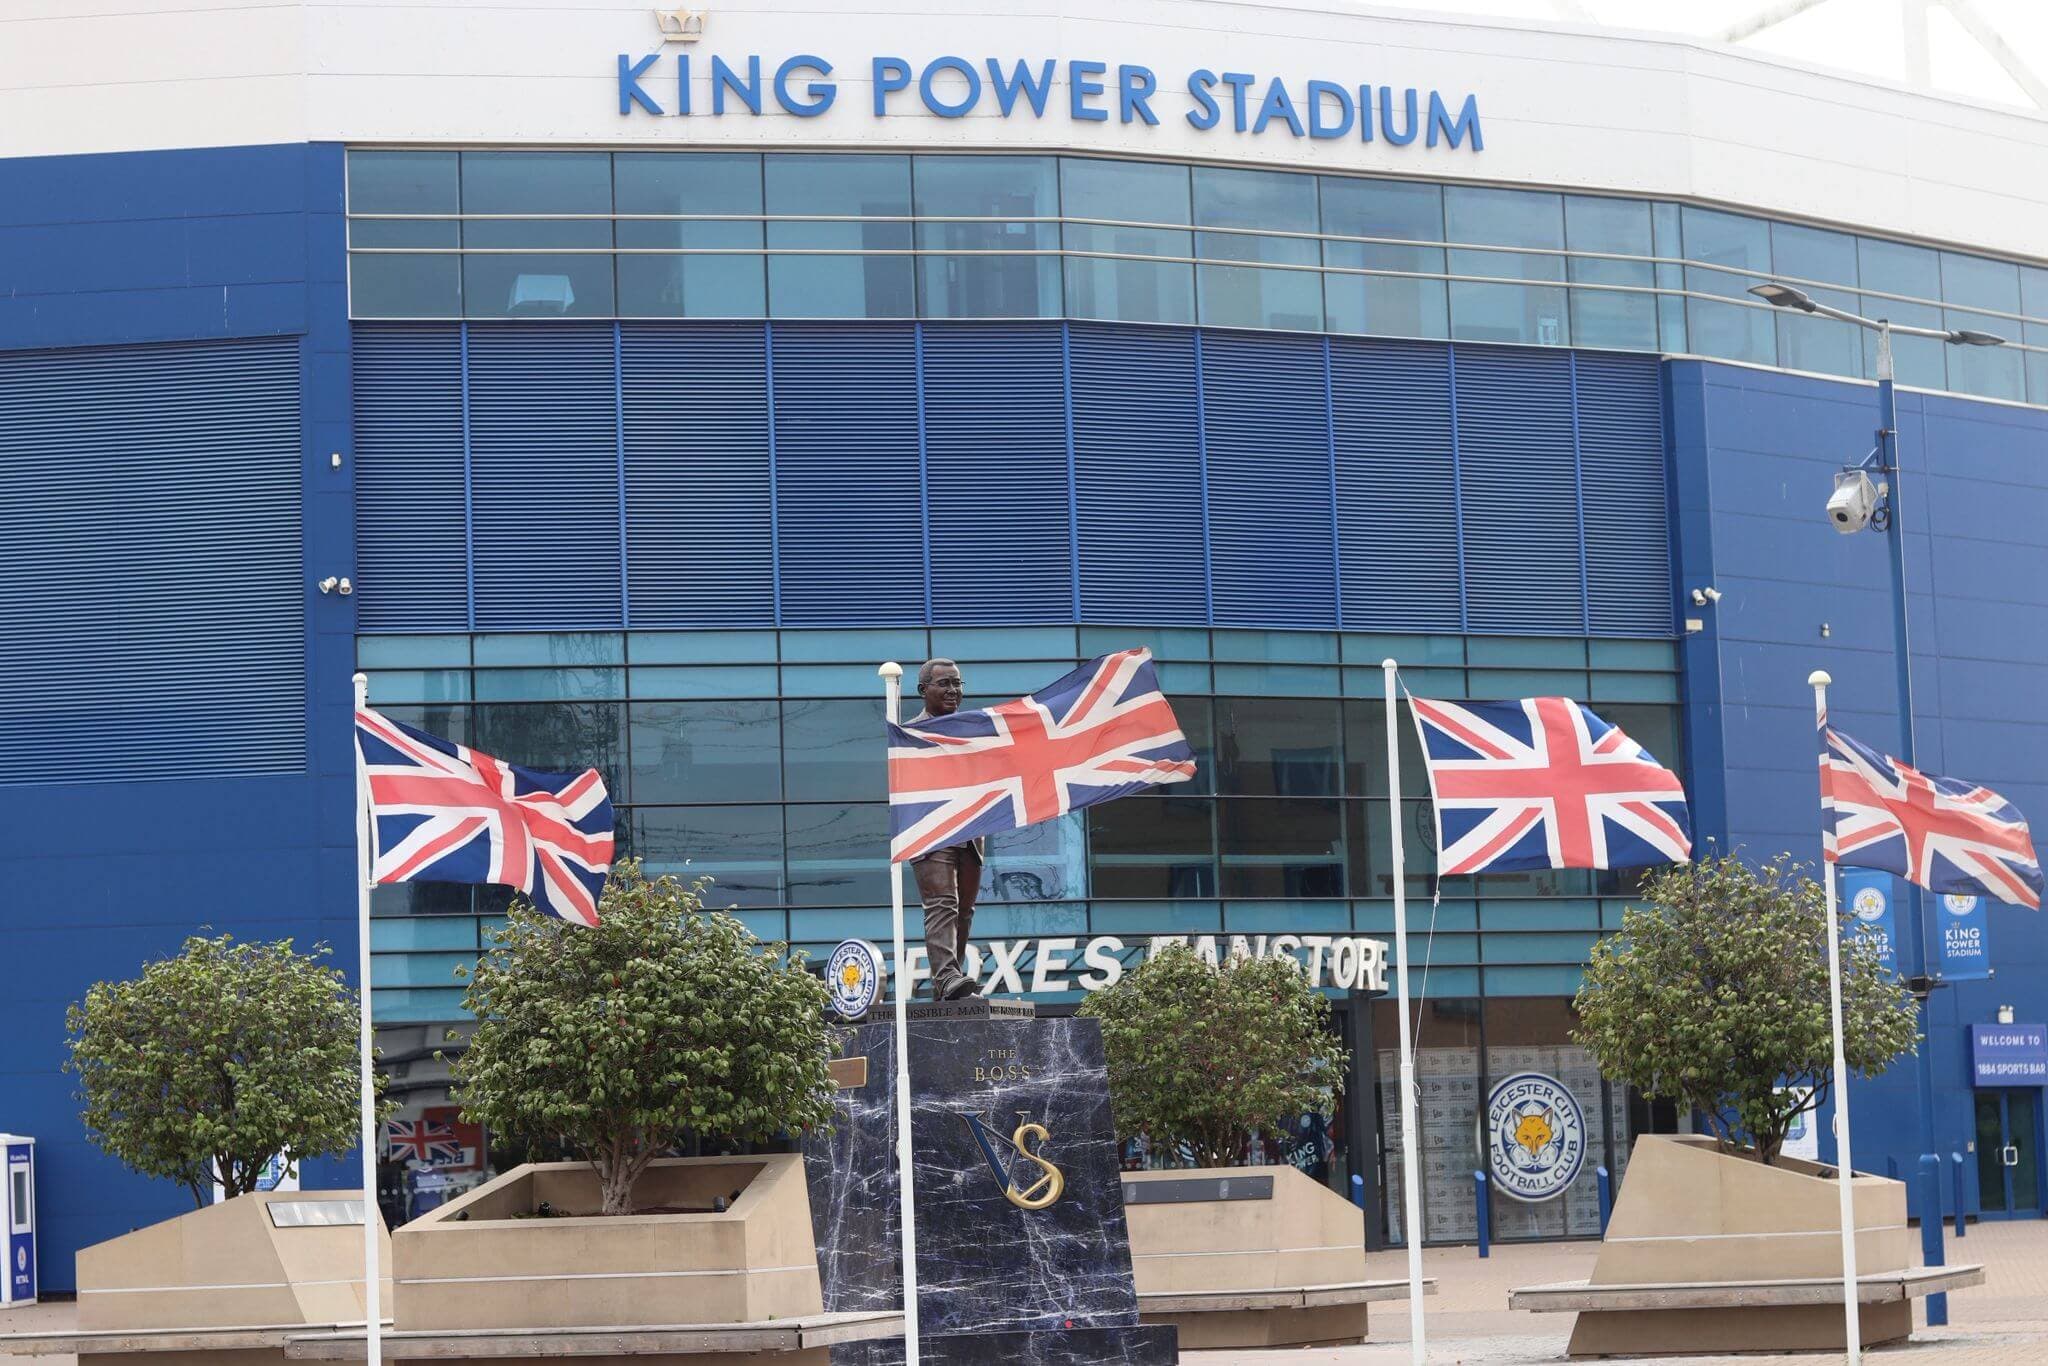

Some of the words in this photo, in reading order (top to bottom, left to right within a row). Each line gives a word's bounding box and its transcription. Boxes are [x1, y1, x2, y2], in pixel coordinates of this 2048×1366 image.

[618, 54, 837, 118] KING
[872, 55, 1160, 125] POWER
[1185, 69, 1484, 152] STADIUM
[1945, 927, 1981, 941] KING
[1946, 939, 1981, 950] POWER
[1947, 948, 1982, 958] STADIUM
[831, 946, 861, 979] LEICESTER
[861, 953, 873, 974] CITY
[860, 980, 873, 1005] CLUB
[870, 1010, 897, 1021] THE
[957, 1004, 986, 1017] MAN
[1980, 1035, 2026, 1046] WELCOME
[2028, 1035, 2041, 1046] TO
[988, 1049, 1017, 1059] THE
[974, 1065, 1031, 1082] BOSS
[1997, 1063, 2029, 1075] SPORTS
[2030, 1063, 2047, 1075] BAR
[1488, 1083, 1554, 1133] LEICESTER
[1554, 1096, 1578, 1131] CITY
[1490, 1143, 1555, 1190] FOOTBALL
[1553, 1140, 1578, 1180] CLUB
